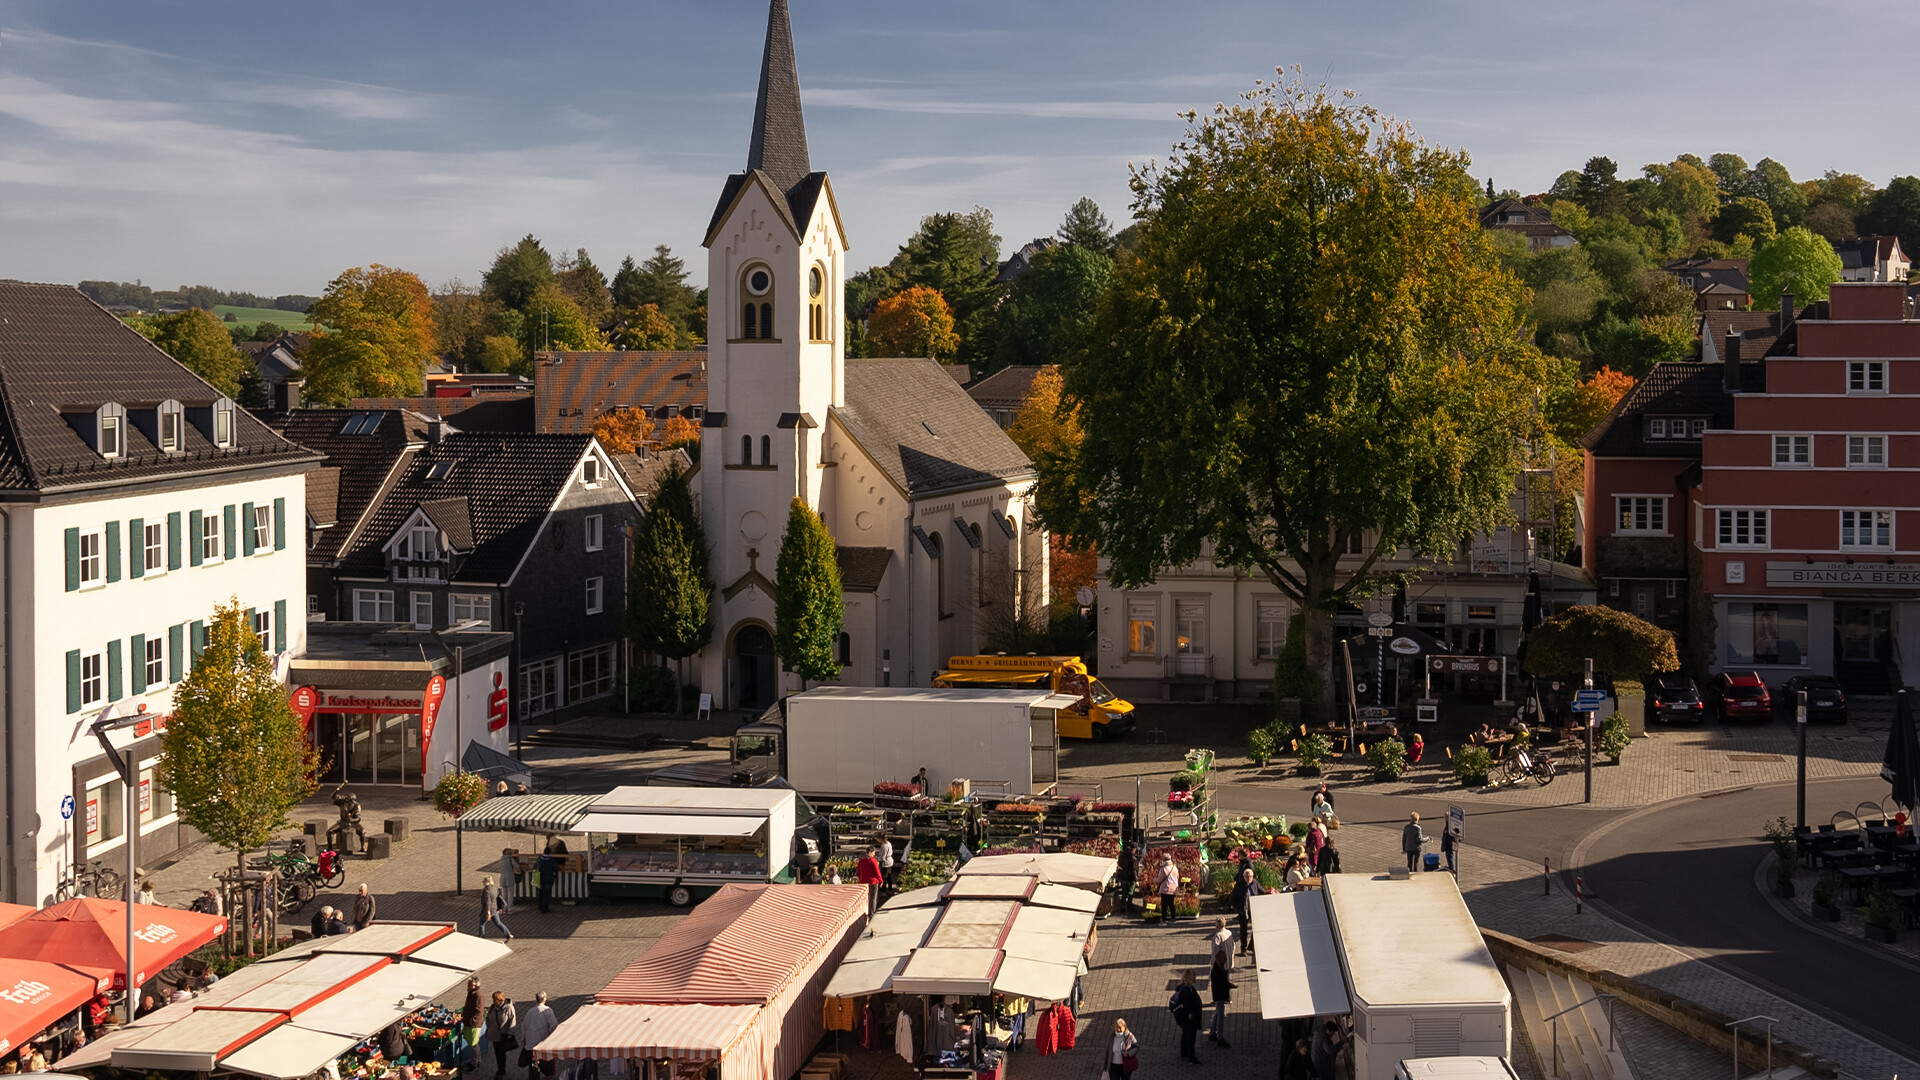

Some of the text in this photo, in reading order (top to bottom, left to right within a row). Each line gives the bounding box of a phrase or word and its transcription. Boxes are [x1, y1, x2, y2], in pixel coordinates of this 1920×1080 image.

[1793, 571, 1920, 583] BIANCA BERK
[1451, 662, 1480, 671] BRAUHAUS
[327, 695, 421, 709] Kreissparkasse
